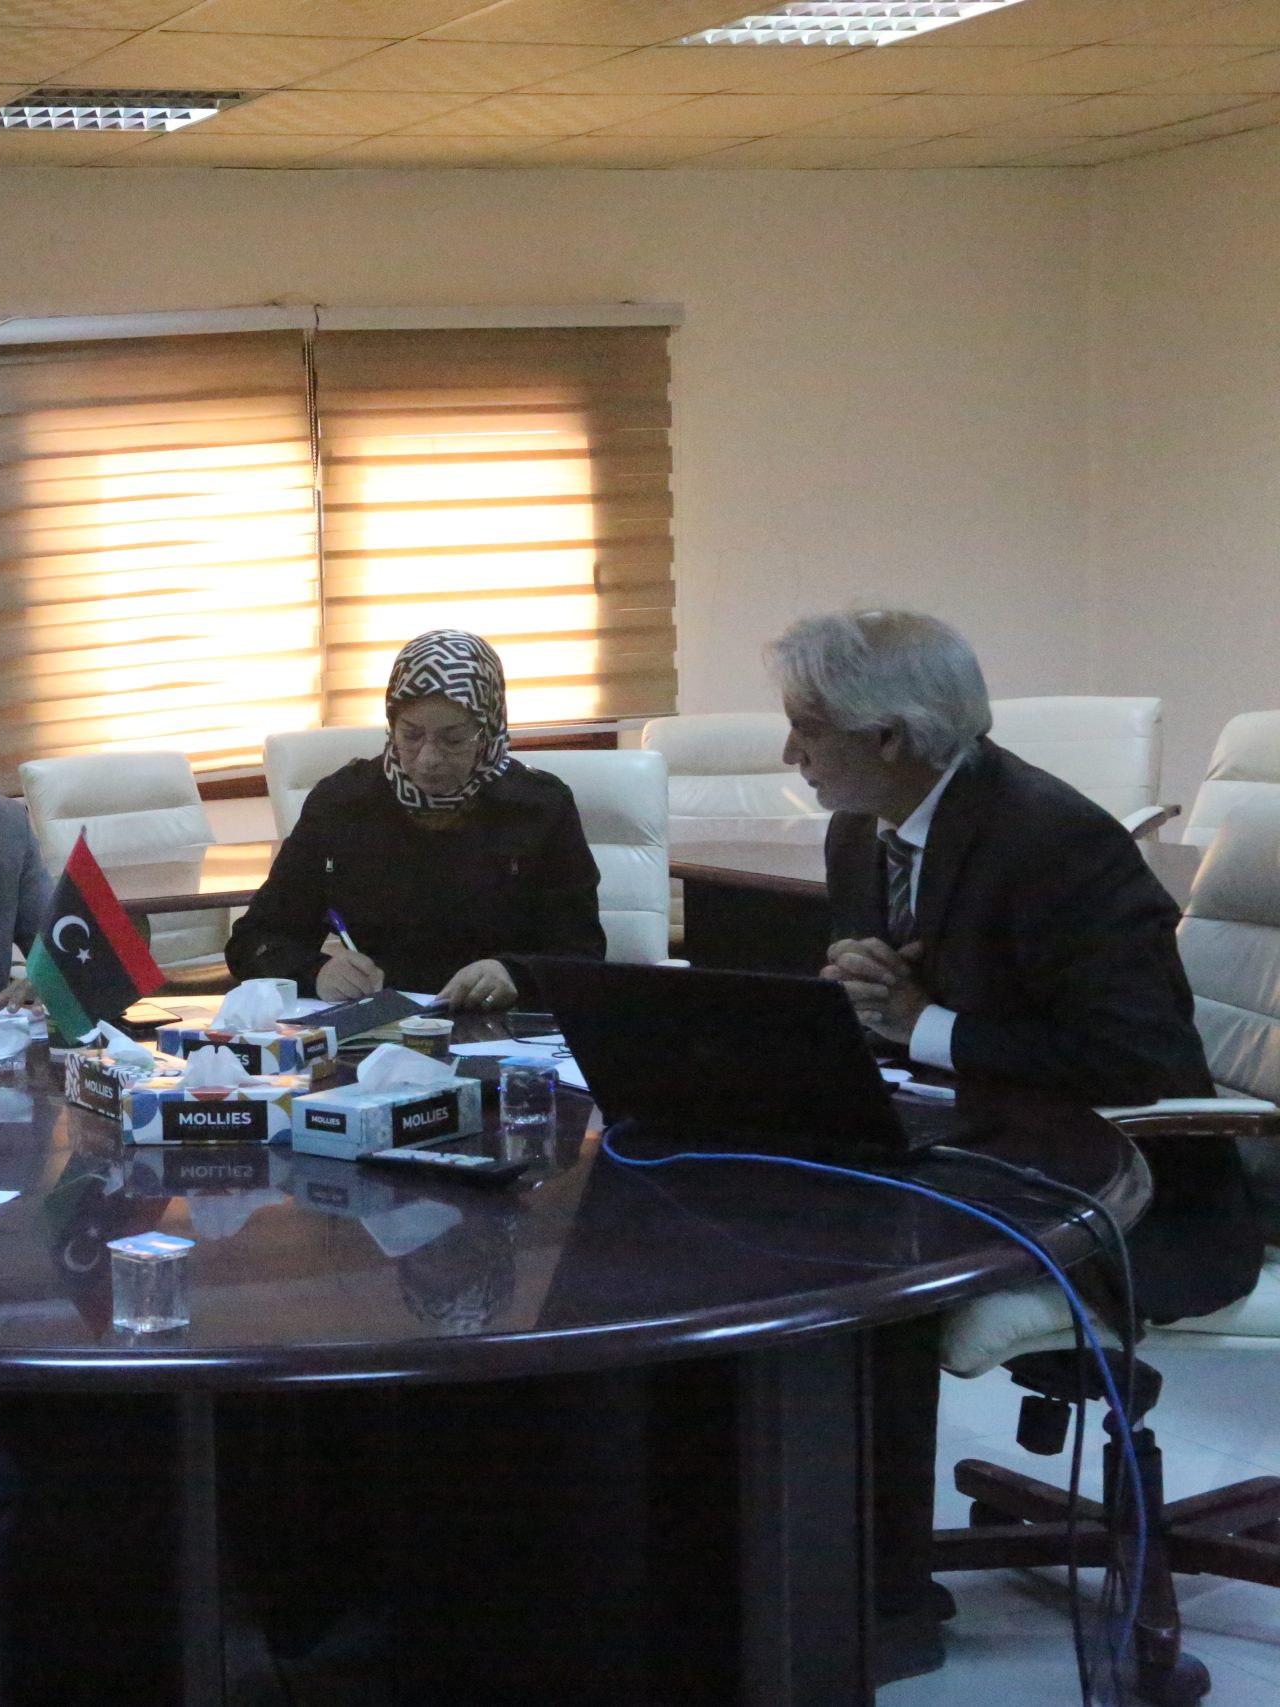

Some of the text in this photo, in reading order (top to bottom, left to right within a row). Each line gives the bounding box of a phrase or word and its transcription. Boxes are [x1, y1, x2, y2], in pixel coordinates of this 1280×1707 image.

[84, 1078, 114, 1099] MOLLIES
[178, 1111, 252, 1126] MOLLIES
[311, 1114, 341, 1127] MOLLIES
[402, 1106, 449, 1131] MOLLIES
